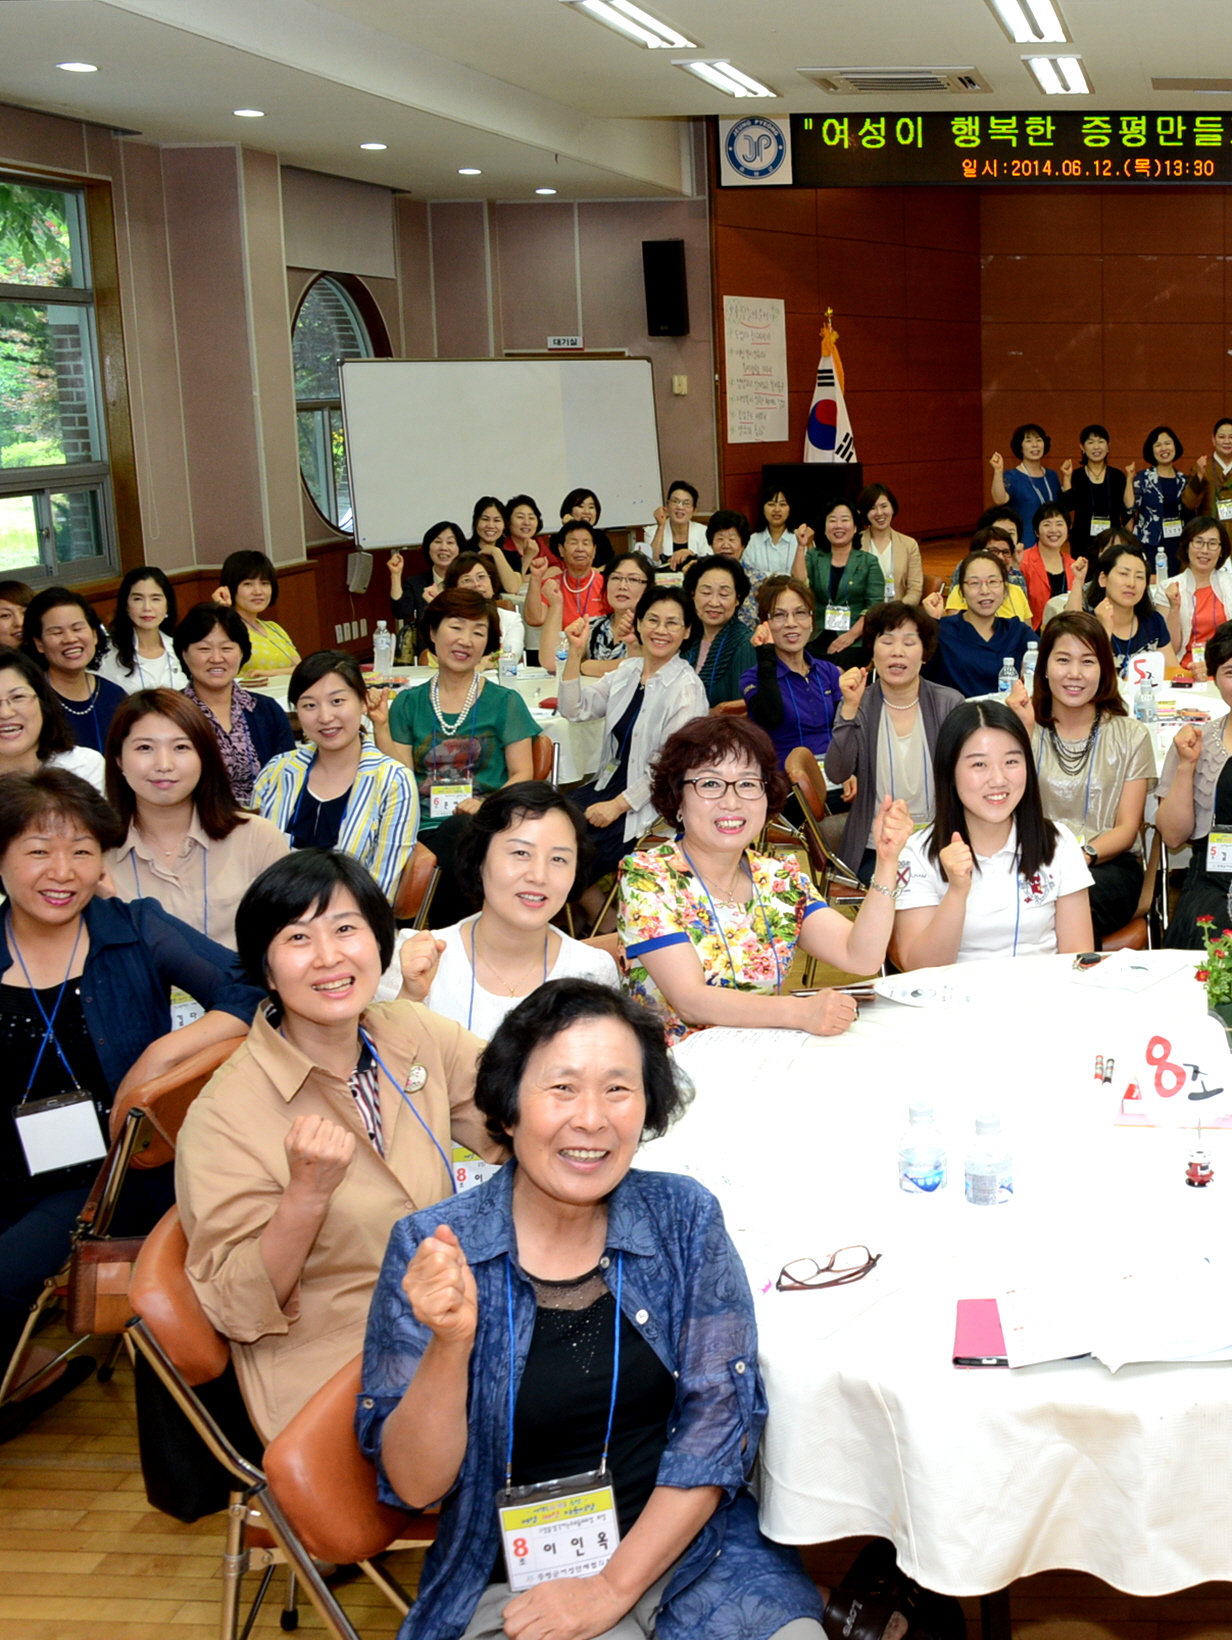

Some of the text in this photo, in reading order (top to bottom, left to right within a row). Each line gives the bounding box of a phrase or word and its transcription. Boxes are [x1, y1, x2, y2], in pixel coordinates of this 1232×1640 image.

[950, 115, 1056, 148] 행복한
[552, 338, 577, 346] 대기실
[1210, 846, 1217, 856] 5
[456, 1167, 467, 1182] 8
[512, 1537, 529, 1558] 8
